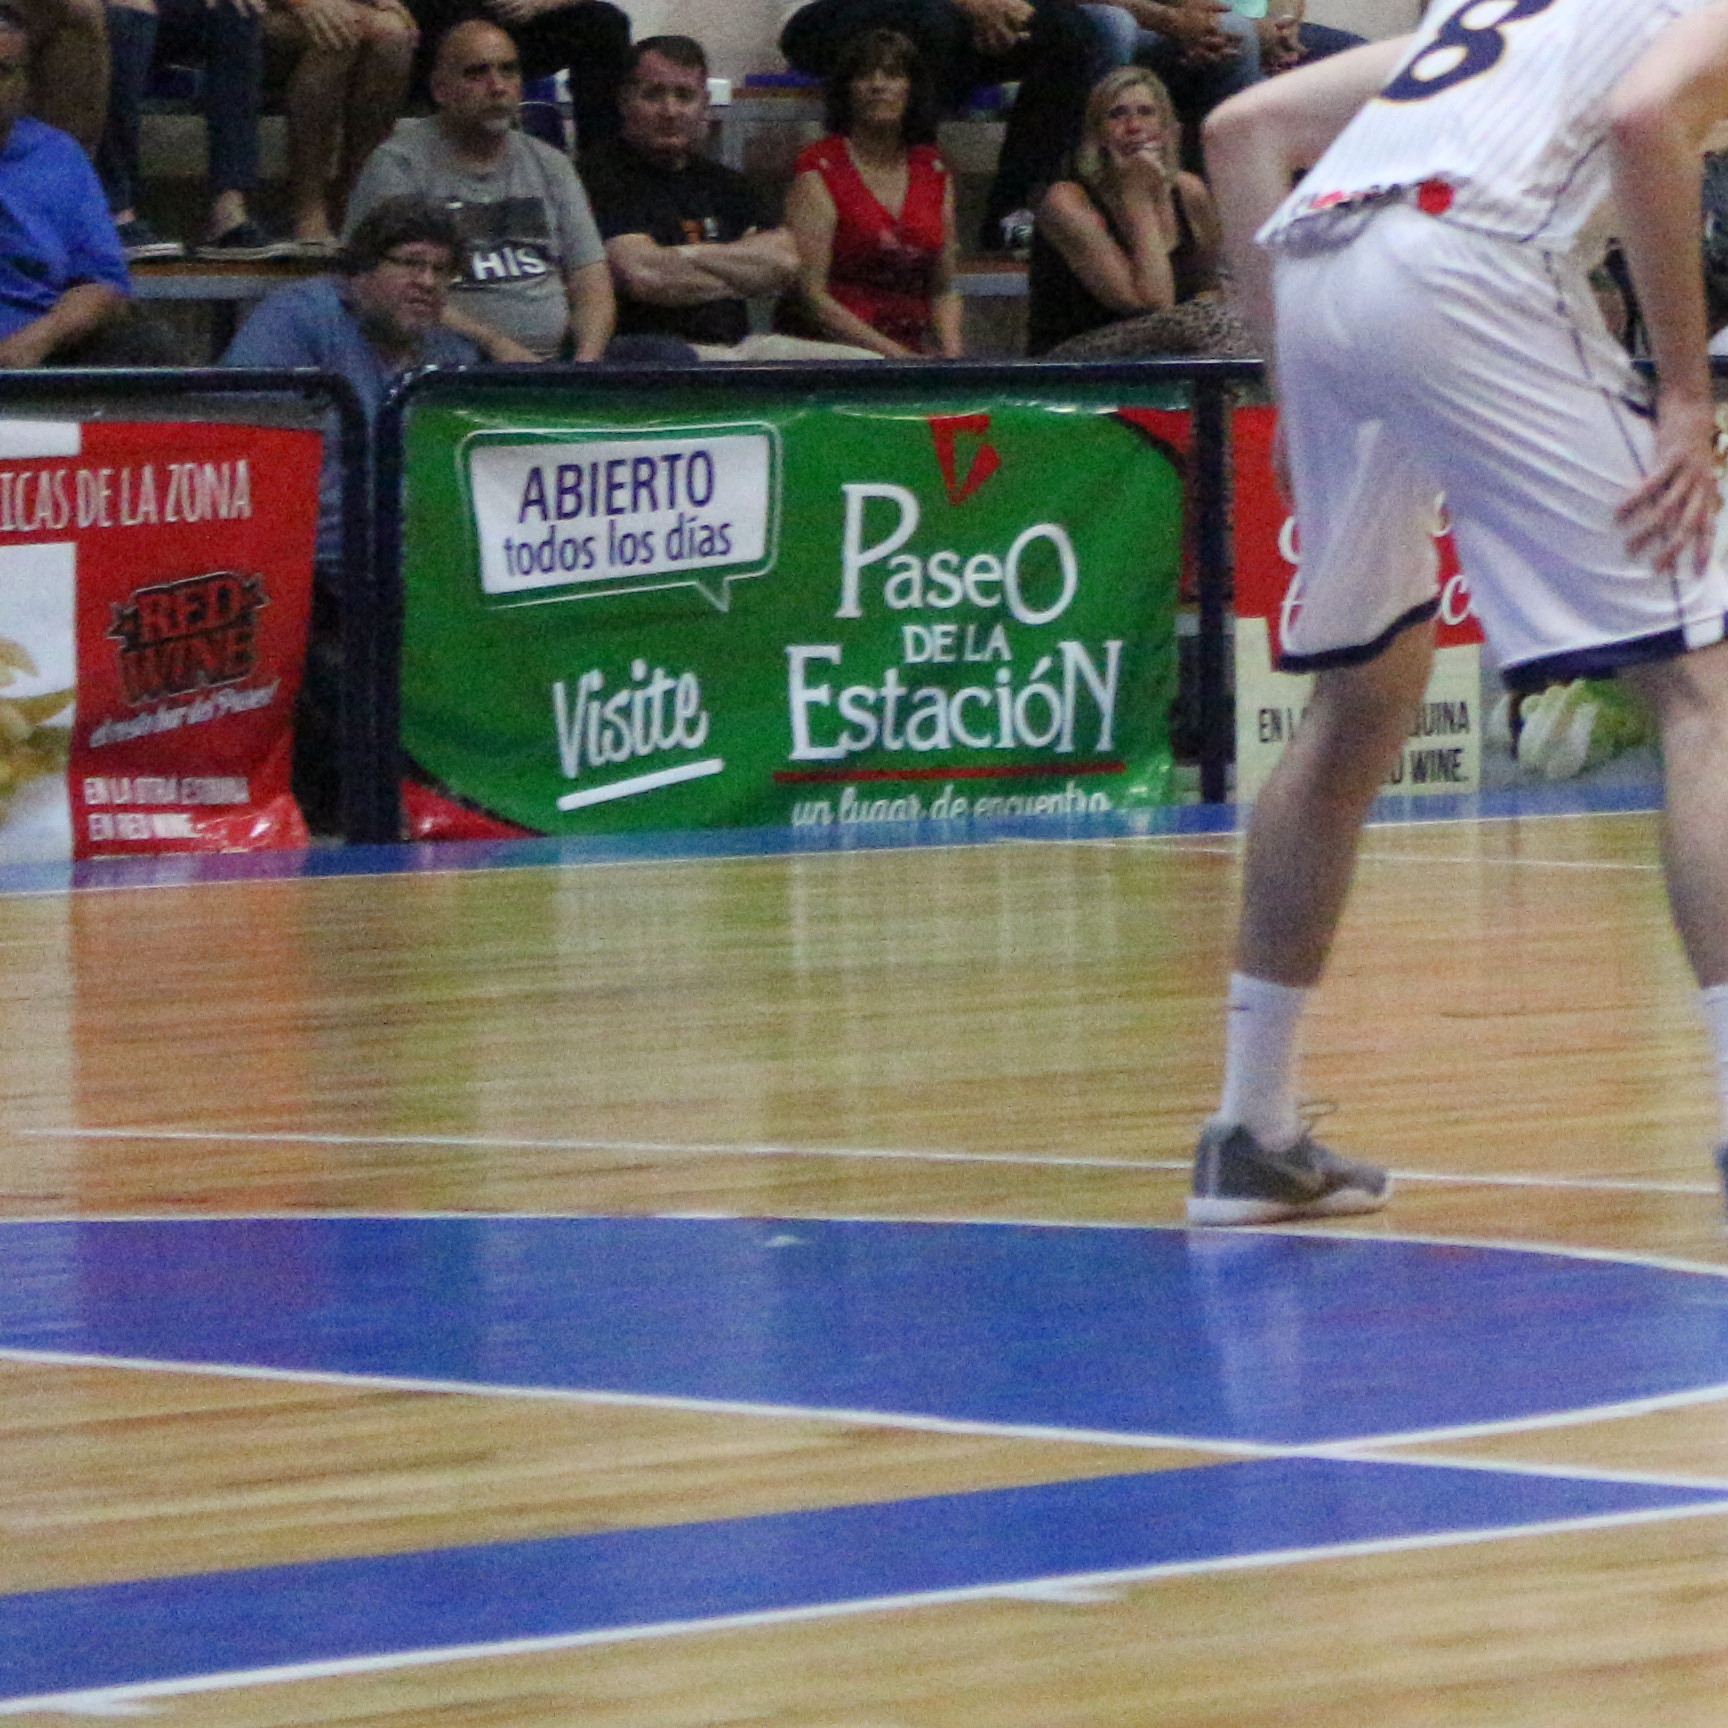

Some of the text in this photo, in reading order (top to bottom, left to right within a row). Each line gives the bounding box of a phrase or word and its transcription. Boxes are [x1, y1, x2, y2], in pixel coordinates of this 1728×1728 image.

[449, 247, 546, 283] HIS
[76, 468, 113, 528] DE
[119, 462, 159, 526] LA
[165, 458, 252, 523] ZONA
[518, 451, 714, 522] ABIERTO
[503, 515, 732, 577] todos los días
[138, 579, 242, 640] RED
[903, 623, 1012, 663] DE LA
[553, 659, 709, 779] Visite
